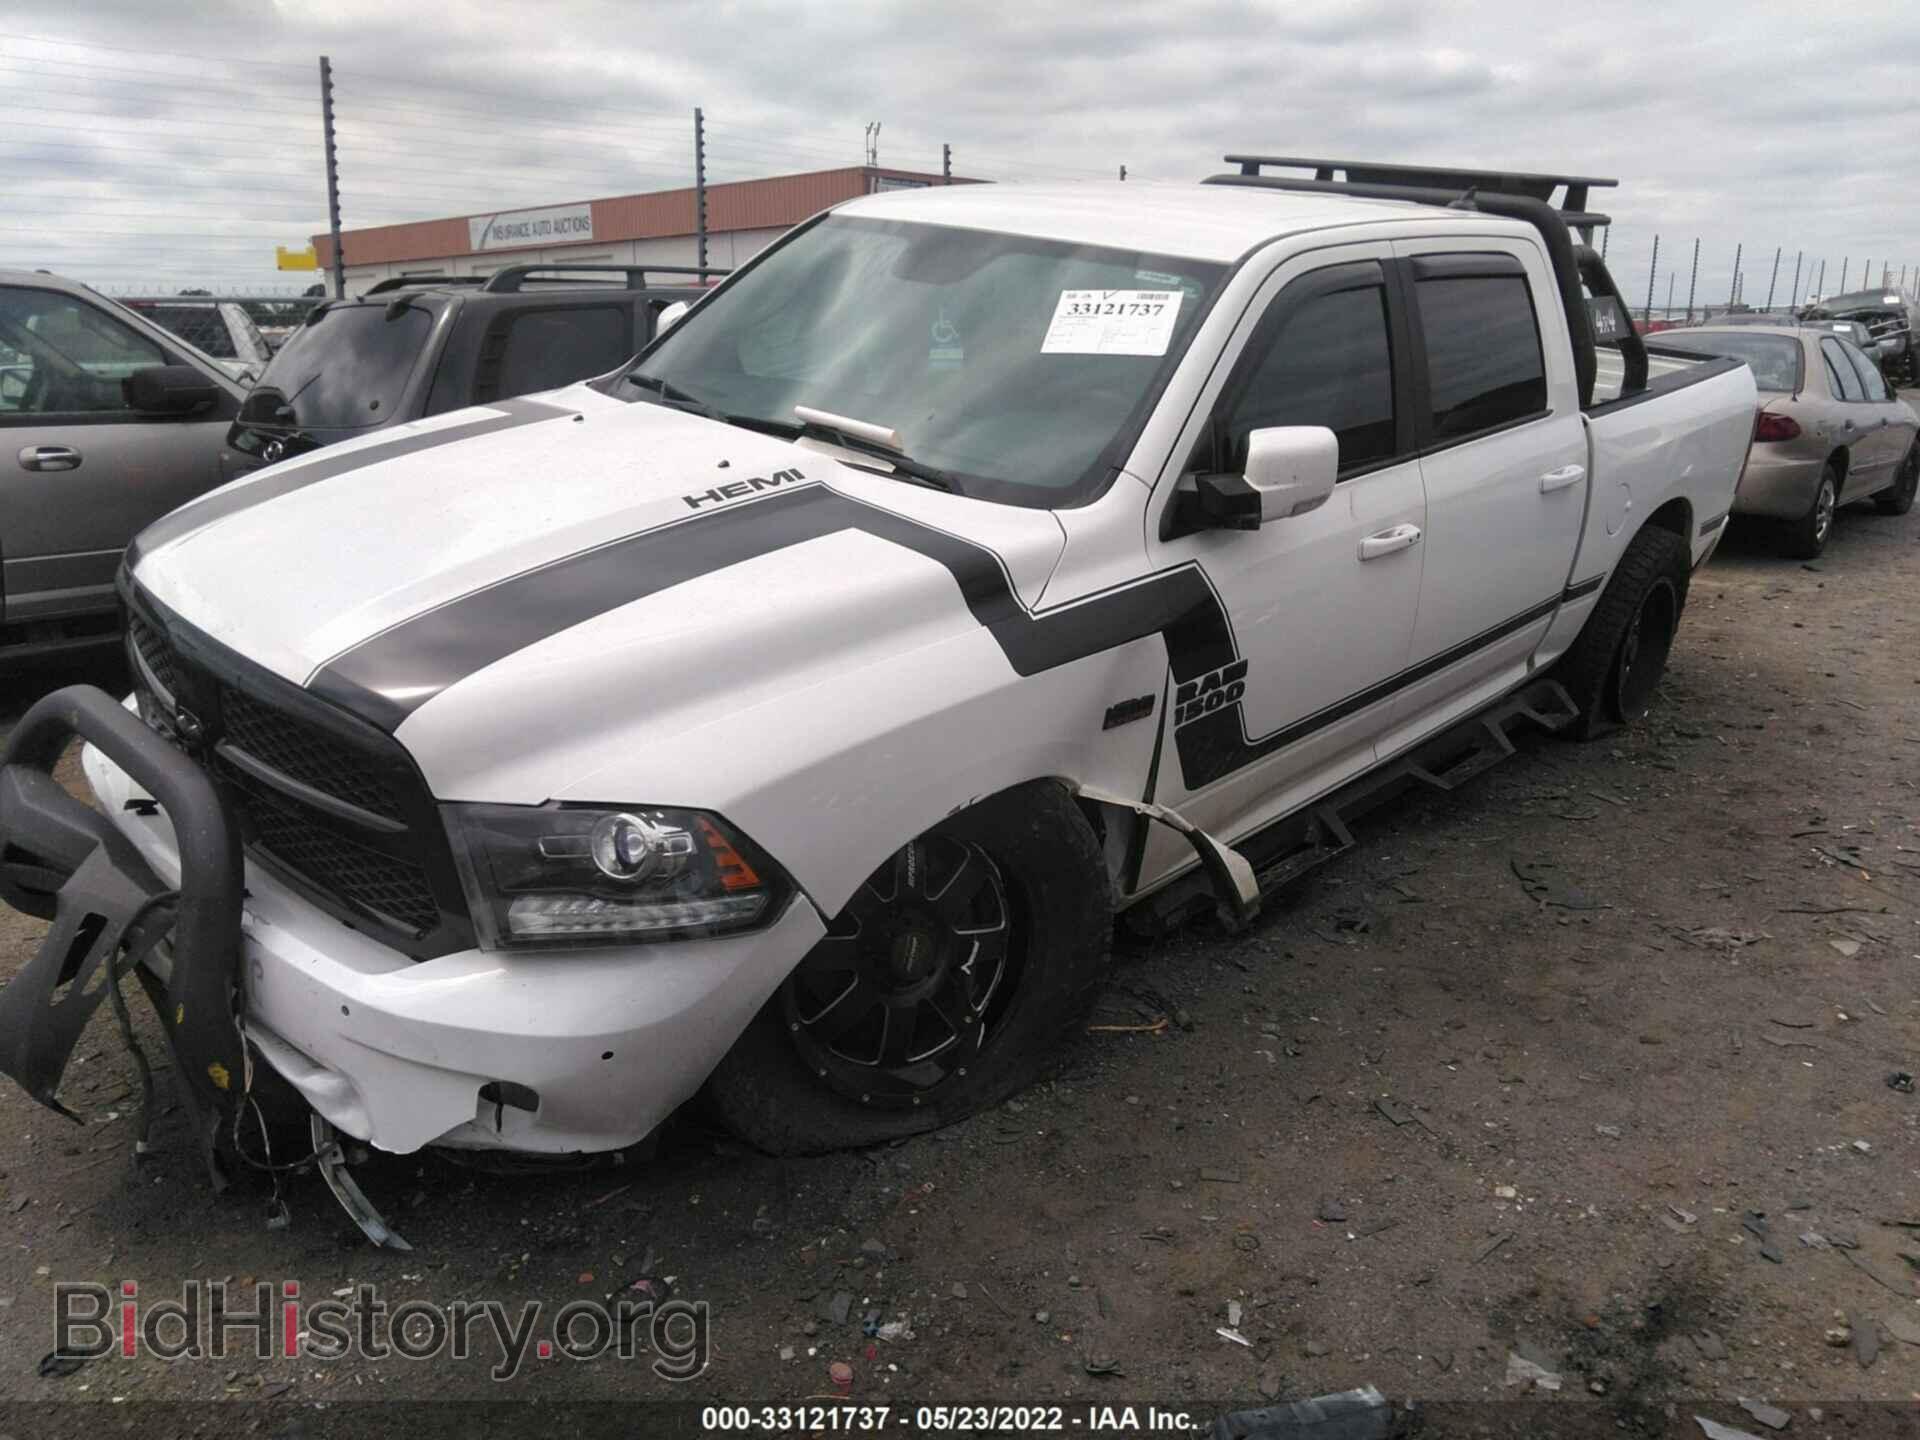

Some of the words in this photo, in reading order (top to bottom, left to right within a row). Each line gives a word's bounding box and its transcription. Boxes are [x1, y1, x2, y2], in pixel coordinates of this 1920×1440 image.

[533, 219, 551, 236] AUTO
[553, 215, 590, 234] AUCTIONS
[1067, 303, 1164, 316] 33121737
[682, 468, 805, 509] HEMI
[1176, 659, 1248, 706] RAM
[1174, 681, 1245, 727] 1500
